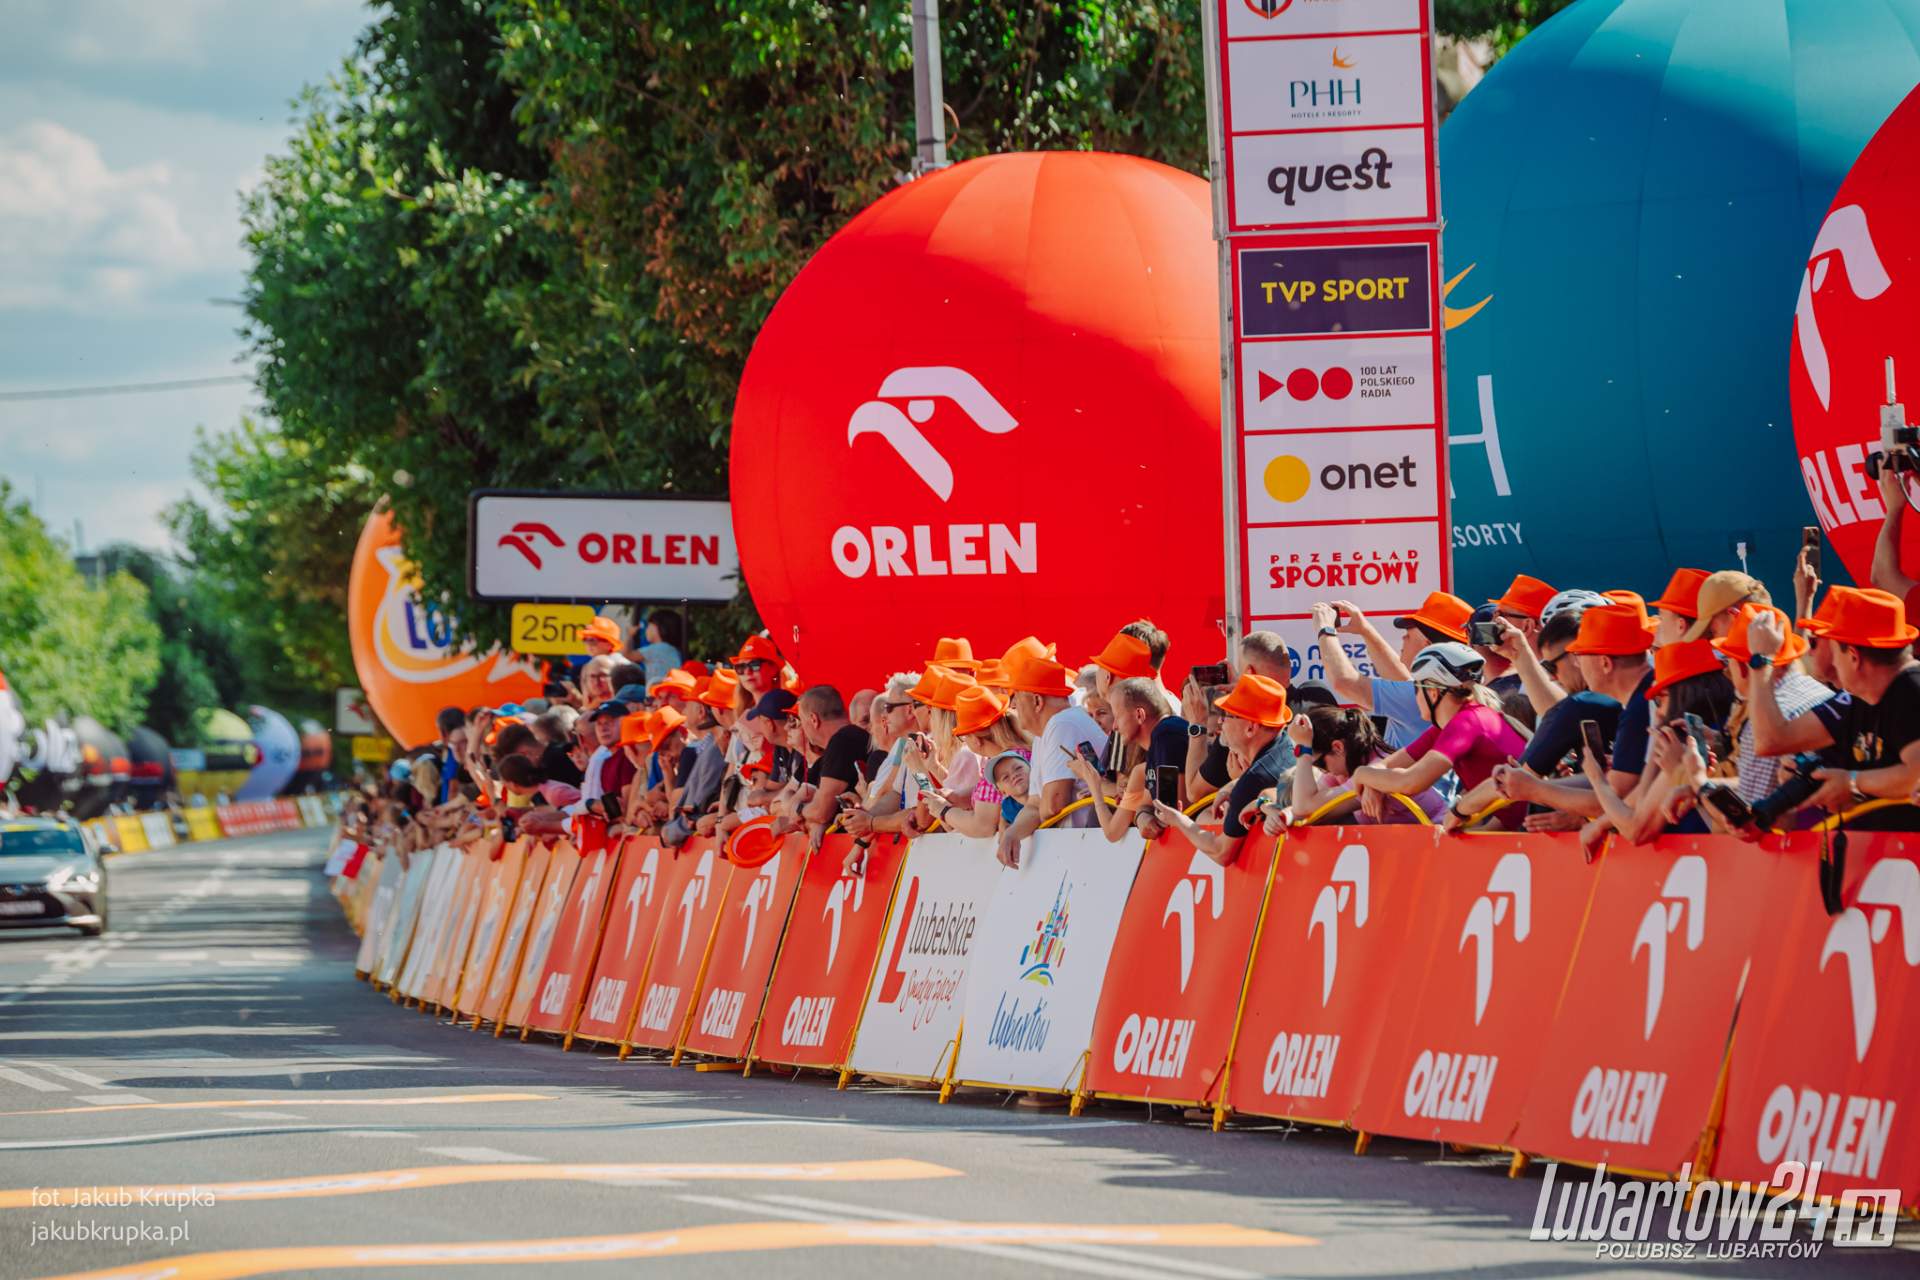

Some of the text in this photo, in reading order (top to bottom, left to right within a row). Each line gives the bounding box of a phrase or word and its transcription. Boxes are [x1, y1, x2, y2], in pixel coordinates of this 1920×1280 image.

[1290, 78, 1361, 107] PHH
[1267, 147, 1393, 206] quest
[1261, 277, 1409, 304] TVP SPORT
[1360, 365, 1397, 375] 100 LAT
[1360, 376, 1415, 387] POLSKIEGO
[1360, 388, 1391, 398] RADIA
[1320, 455, 1417, 491] onet
[578, 533, 719, 565] ORLEN
[831, 522, 1037, 579] ORLEN
[1450, 521, 1524, 549] SORTY
[1269, 561, 1419, 589] SPORTOWY
[701, 987, 746, 1039] ORLEN
[782, 996, 836, 1046] ORLEN
[1114, 1013, 1196, 1079] ORLEN
[1263, 1031, 1340, 1098] ORLEN
[1404, 1050, 1498, 1123] ORLEN
[1571, 1067, 1667, 1145] ORLEN
[1757, 1084, 1896, 1180] ORLEN
